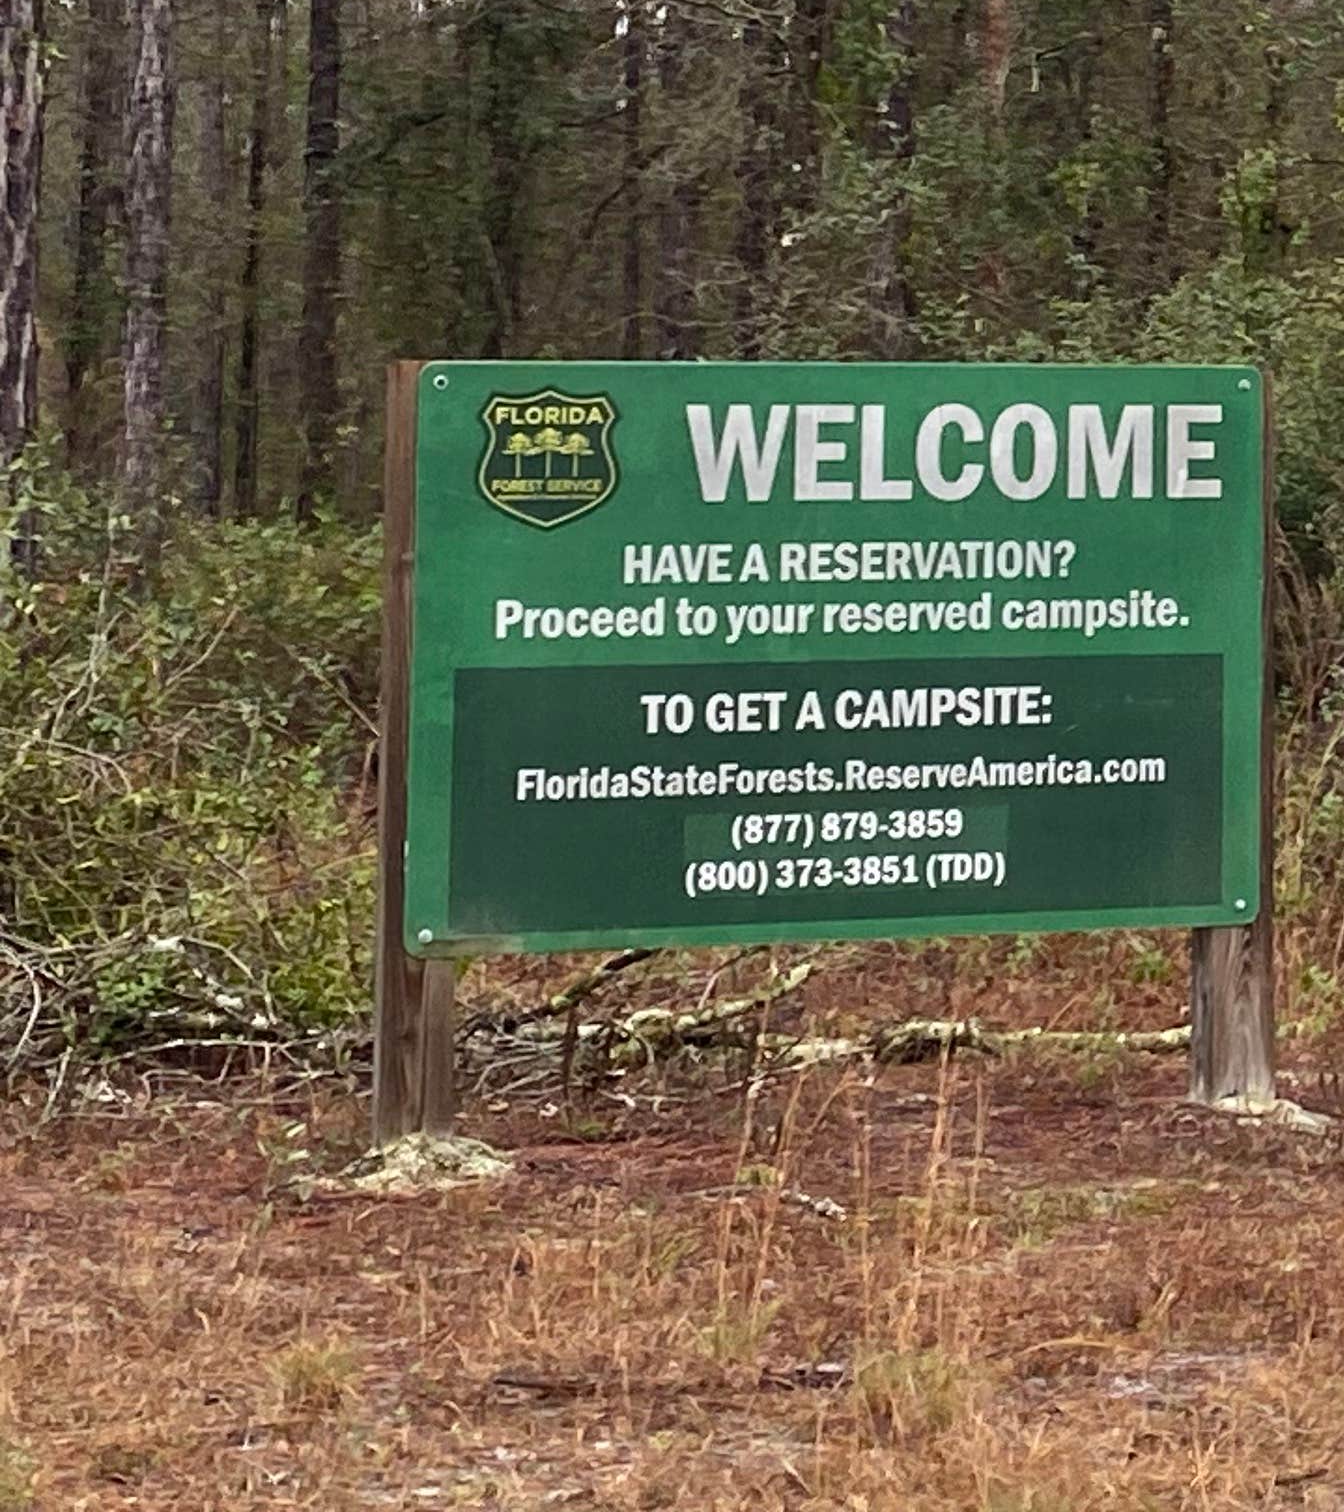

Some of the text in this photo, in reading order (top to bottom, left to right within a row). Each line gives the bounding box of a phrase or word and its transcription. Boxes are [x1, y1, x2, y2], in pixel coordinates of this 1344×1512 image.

[495, 406, 604, 426] FLORIDA
[686, 404, 1222, 501] WELCOME
[492, 479, 603, 492] FOREST SERVICE
[624, 540, 1075, 583] HAVE A RESERVATION?
[496, 590, 1188, 643] Proceed to your reserved campsite.
[641, 686, 1051, 733] TO GET A CAMPSITE:
[517, 755, 1165, 800] FloridaStateForests.ReserveAmerica.com
[732, 809, 962, 850] (877) 879-3859
[686, 852, 1005, 897] (800) 373-3851 (TDD)
